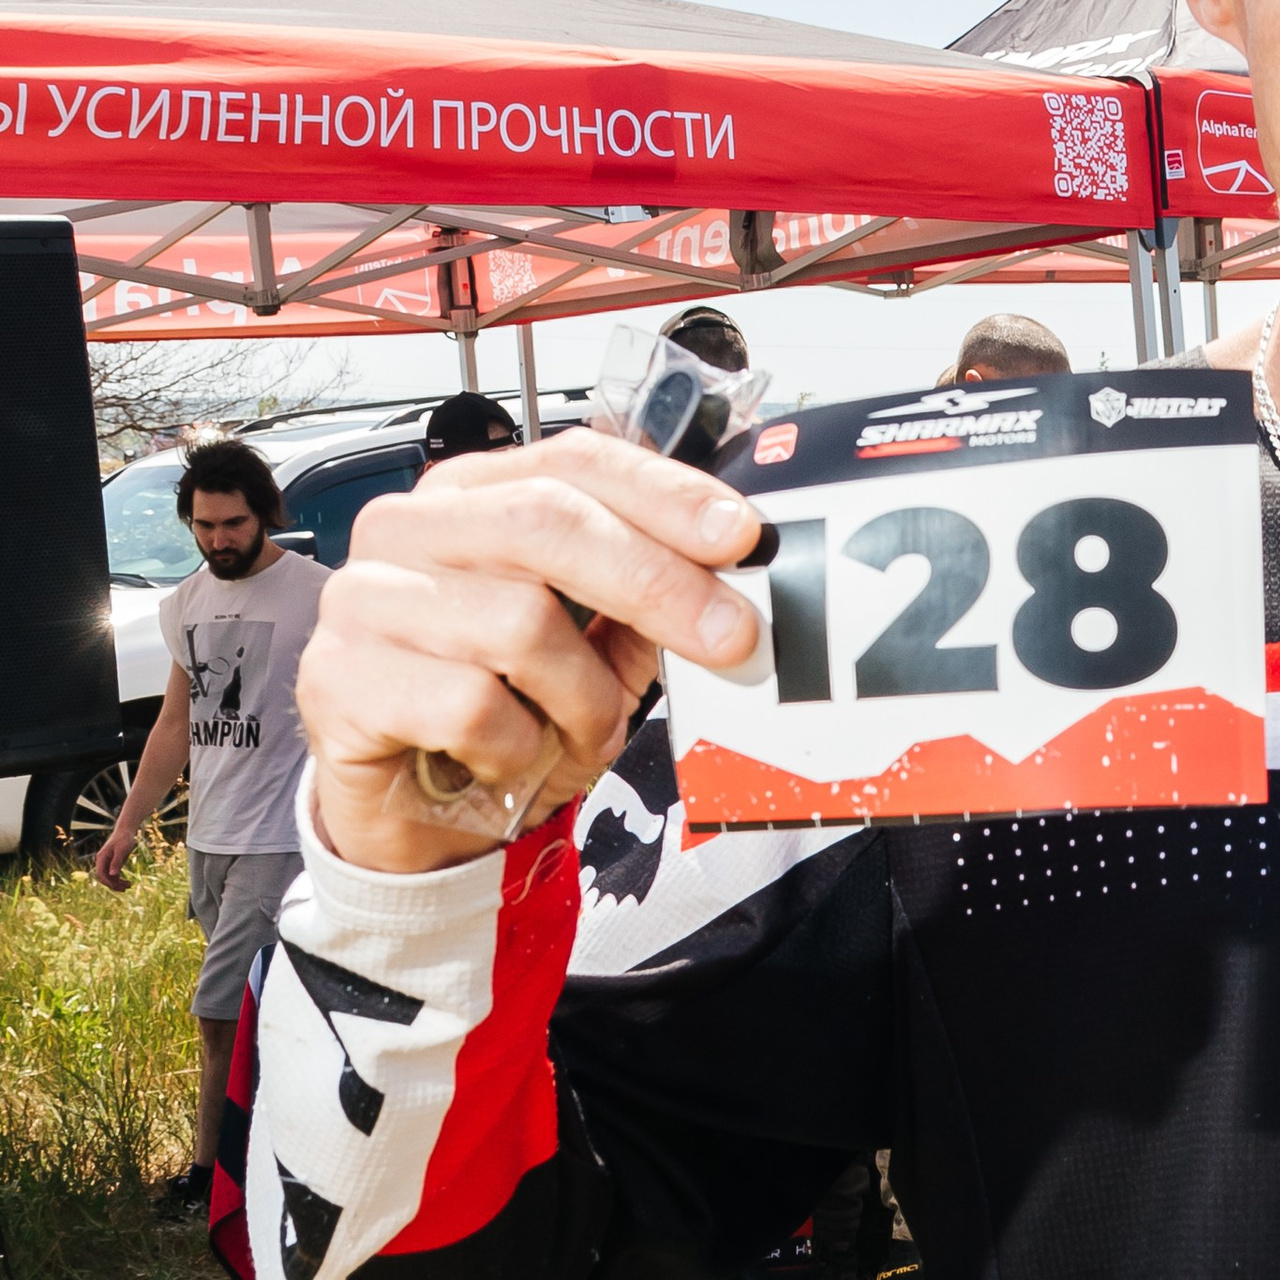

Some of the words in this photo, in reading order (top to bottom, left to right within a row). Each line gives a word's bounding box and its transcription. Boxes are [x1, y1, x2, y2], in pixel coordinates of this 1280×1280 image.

[47, 84, 414, 149] УСИЛЕННОЙ
[432, 99, 735, 160] ПРОЧНОСТИ
[856, 409, 1044, 447] SHARMAX
[968, 430, 1037, 448] MOTORS
[764, 496, 1178, 704] 128
